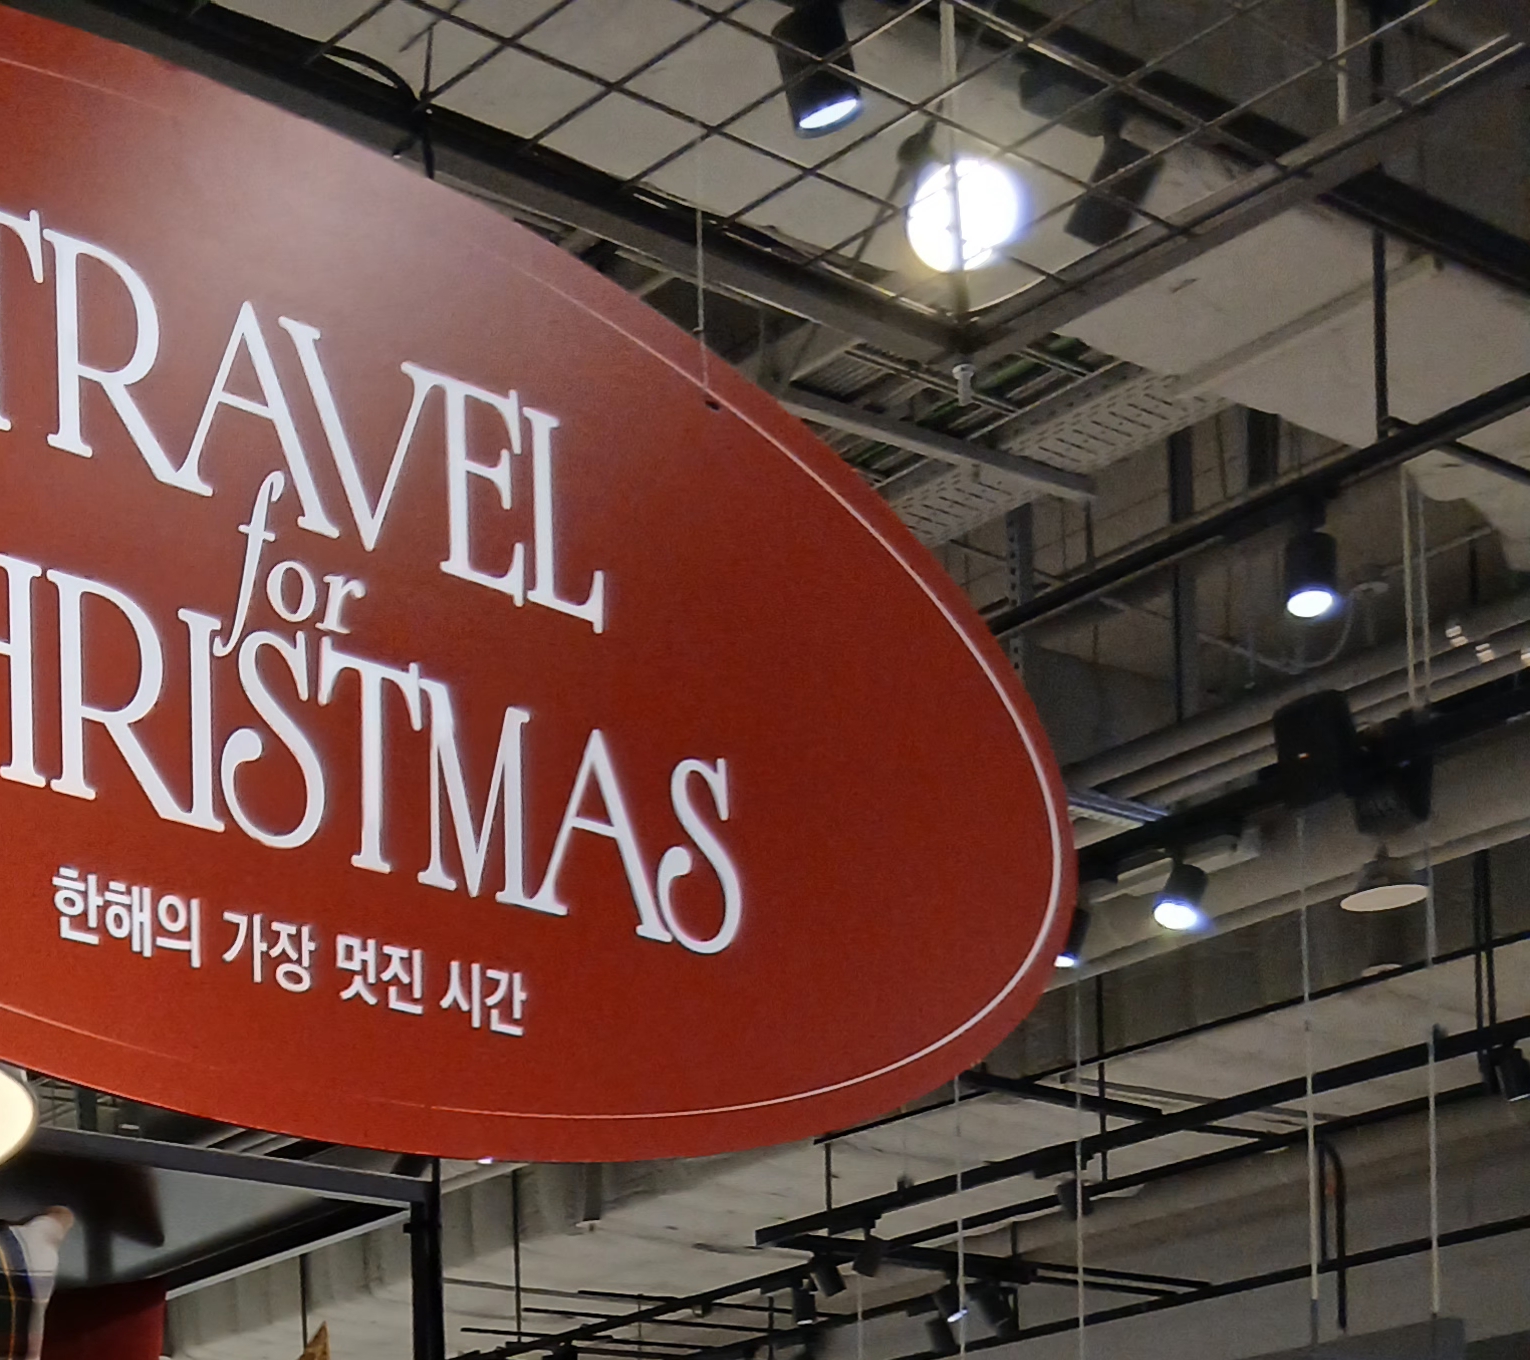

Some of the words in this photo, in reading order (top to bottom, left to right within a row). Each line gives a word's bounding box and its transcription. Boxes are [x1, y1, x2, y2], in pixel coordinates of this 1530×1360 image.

[213, 470, 367, 657] for
[50, 864, 202, 968] 한해의
[221, 908, 317, 994] 가장
[334, 930, 425, 1017] 멋진
[438, 960, 529, 1038] 시간
